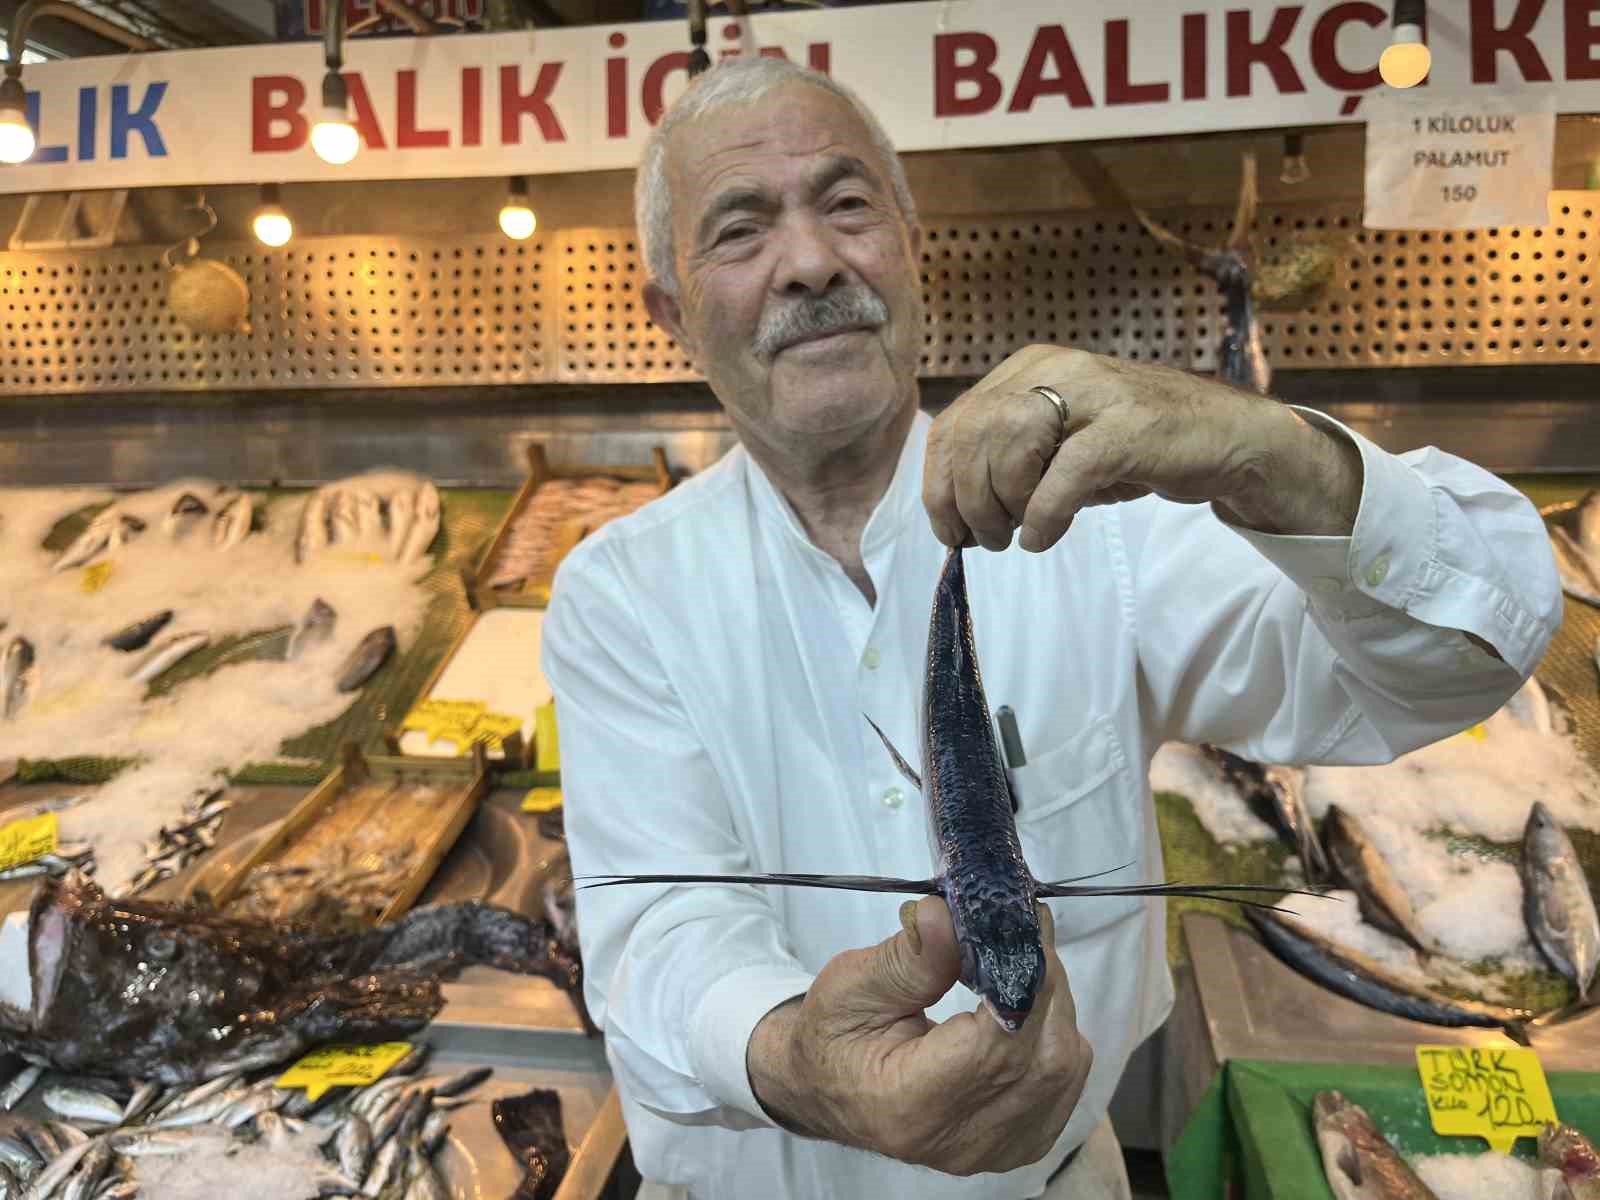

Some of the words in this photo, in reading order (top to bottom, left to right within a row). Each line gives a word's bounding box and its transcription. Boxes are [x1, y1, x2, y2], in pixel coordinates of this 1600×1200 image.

[251, 61, 567, 153] BALIK
[933, 1, 1429, 118] BALIKÇ
[1413, 150, 1510, 168] PALAMUT
[1441, 185, 1477, 202] 150
